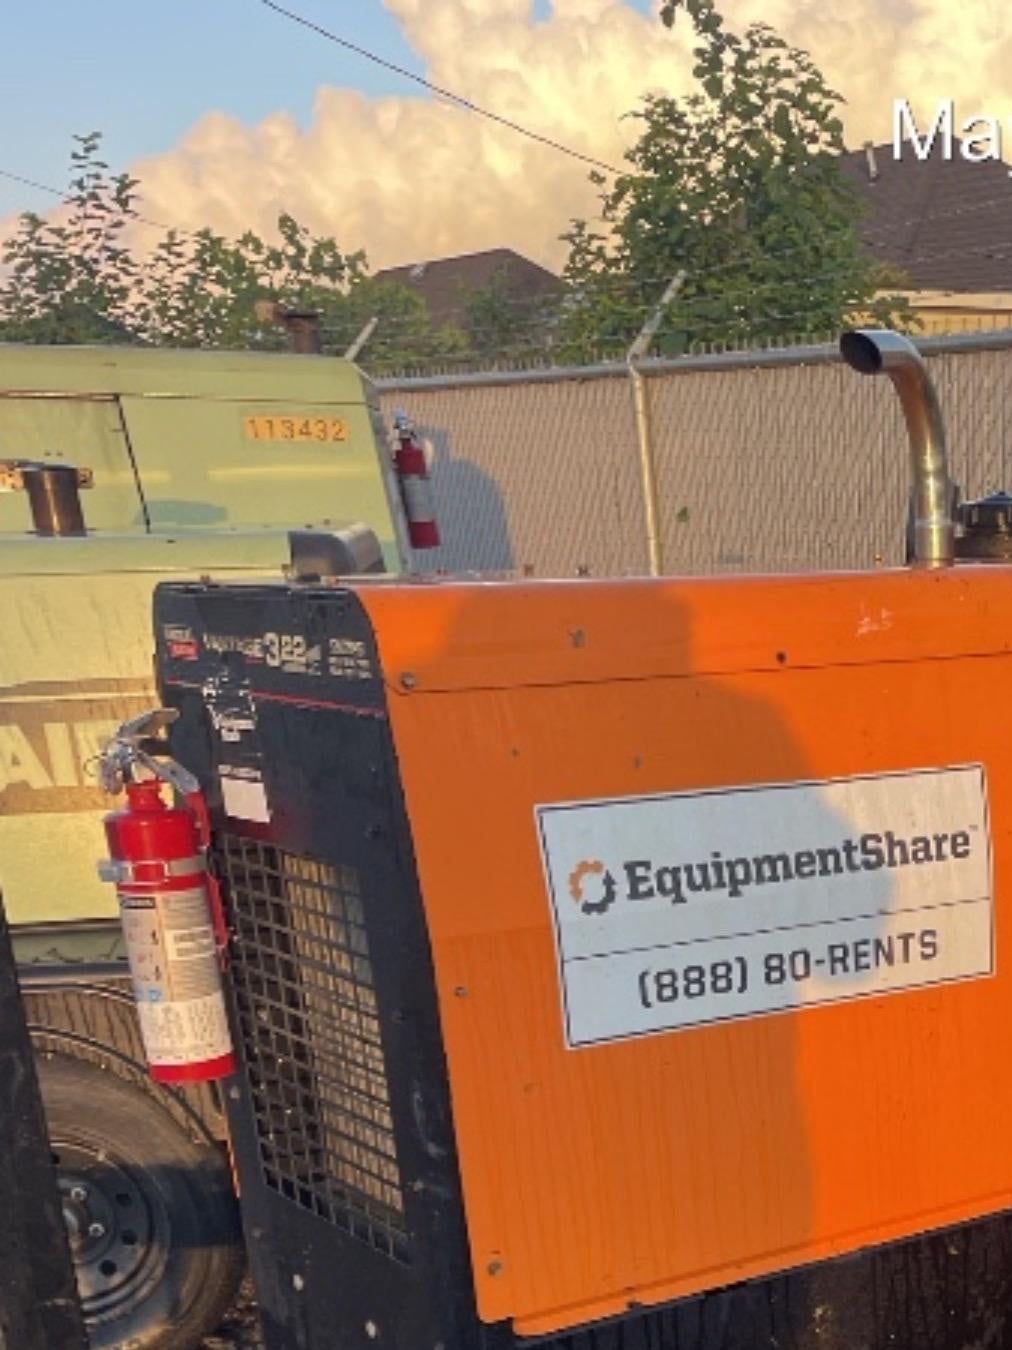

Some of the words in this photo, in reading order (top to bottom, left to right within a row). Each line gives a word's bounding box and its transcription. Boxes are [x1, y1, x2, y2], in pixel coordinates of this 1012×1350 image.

[247, 418, 346, 442] 113432
[622, 828, 972, 904] EquipmentShare
[637, 956, 749, 1009] (888)
[763, 928, 939, 987] 80-RENTS
